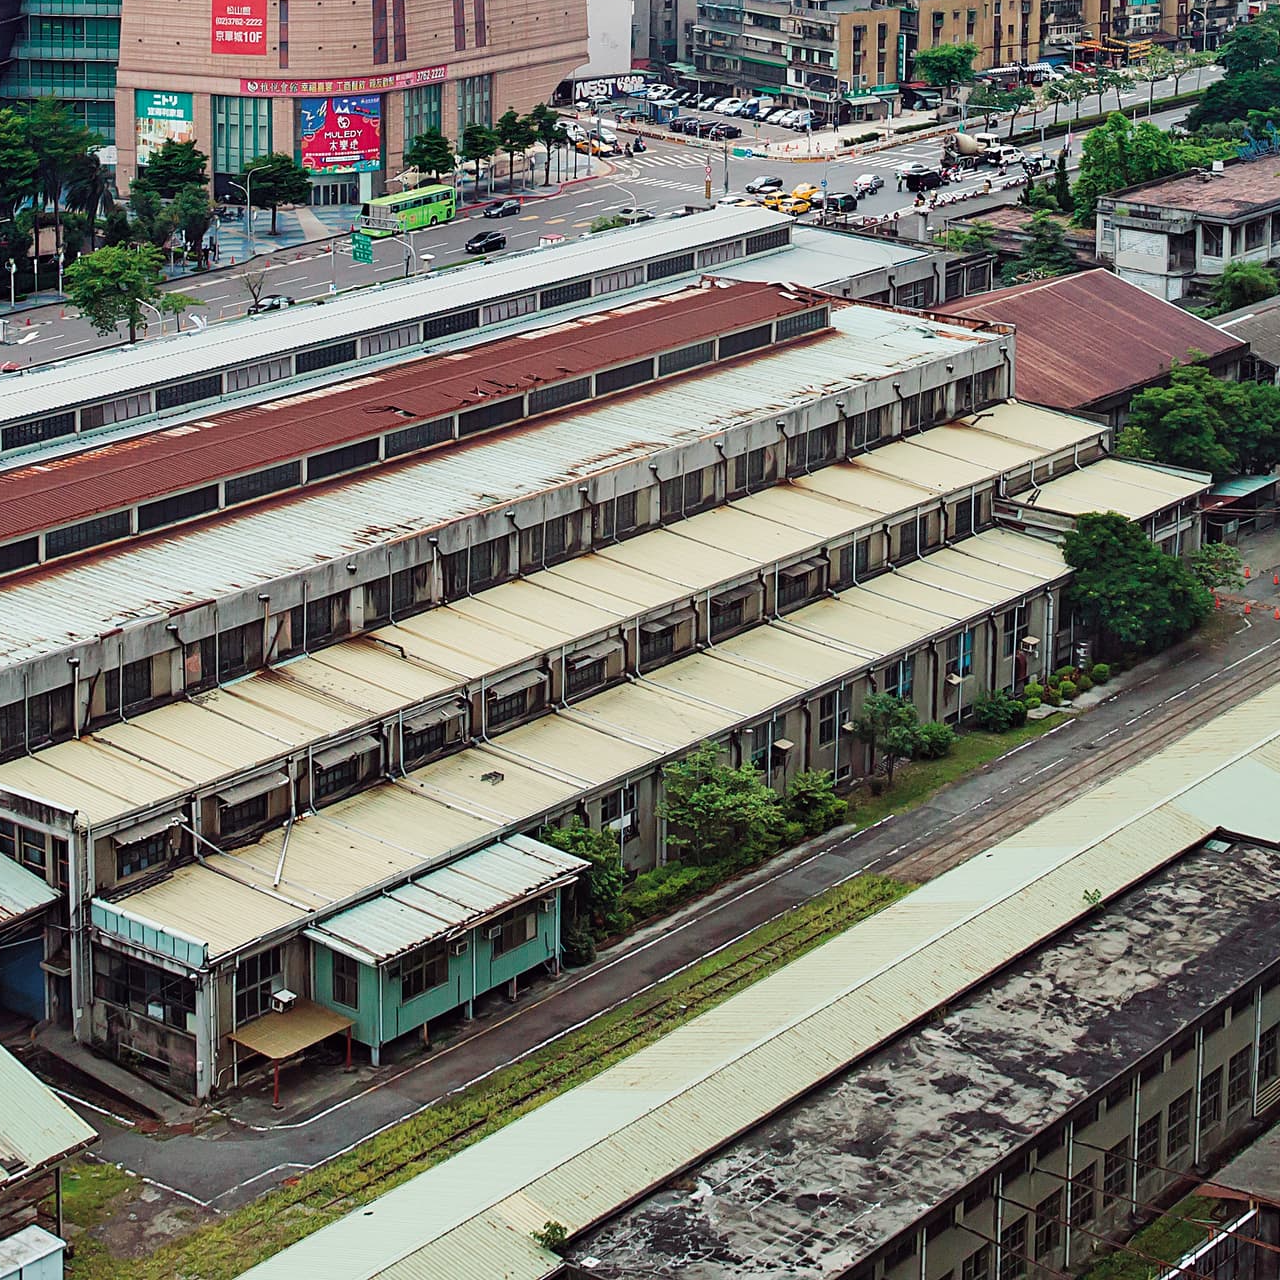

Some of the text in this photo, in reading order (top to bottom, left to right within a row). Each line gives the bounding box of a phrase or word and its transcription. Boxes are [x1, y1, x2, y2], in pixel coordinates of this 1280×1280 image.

[416, 67, 445, 82] 3762-2222
[576, 78, 616, 100] NEST
[153, 94, 178, 107] ニトリ
[324, 130, 363, 139] MULEDY
